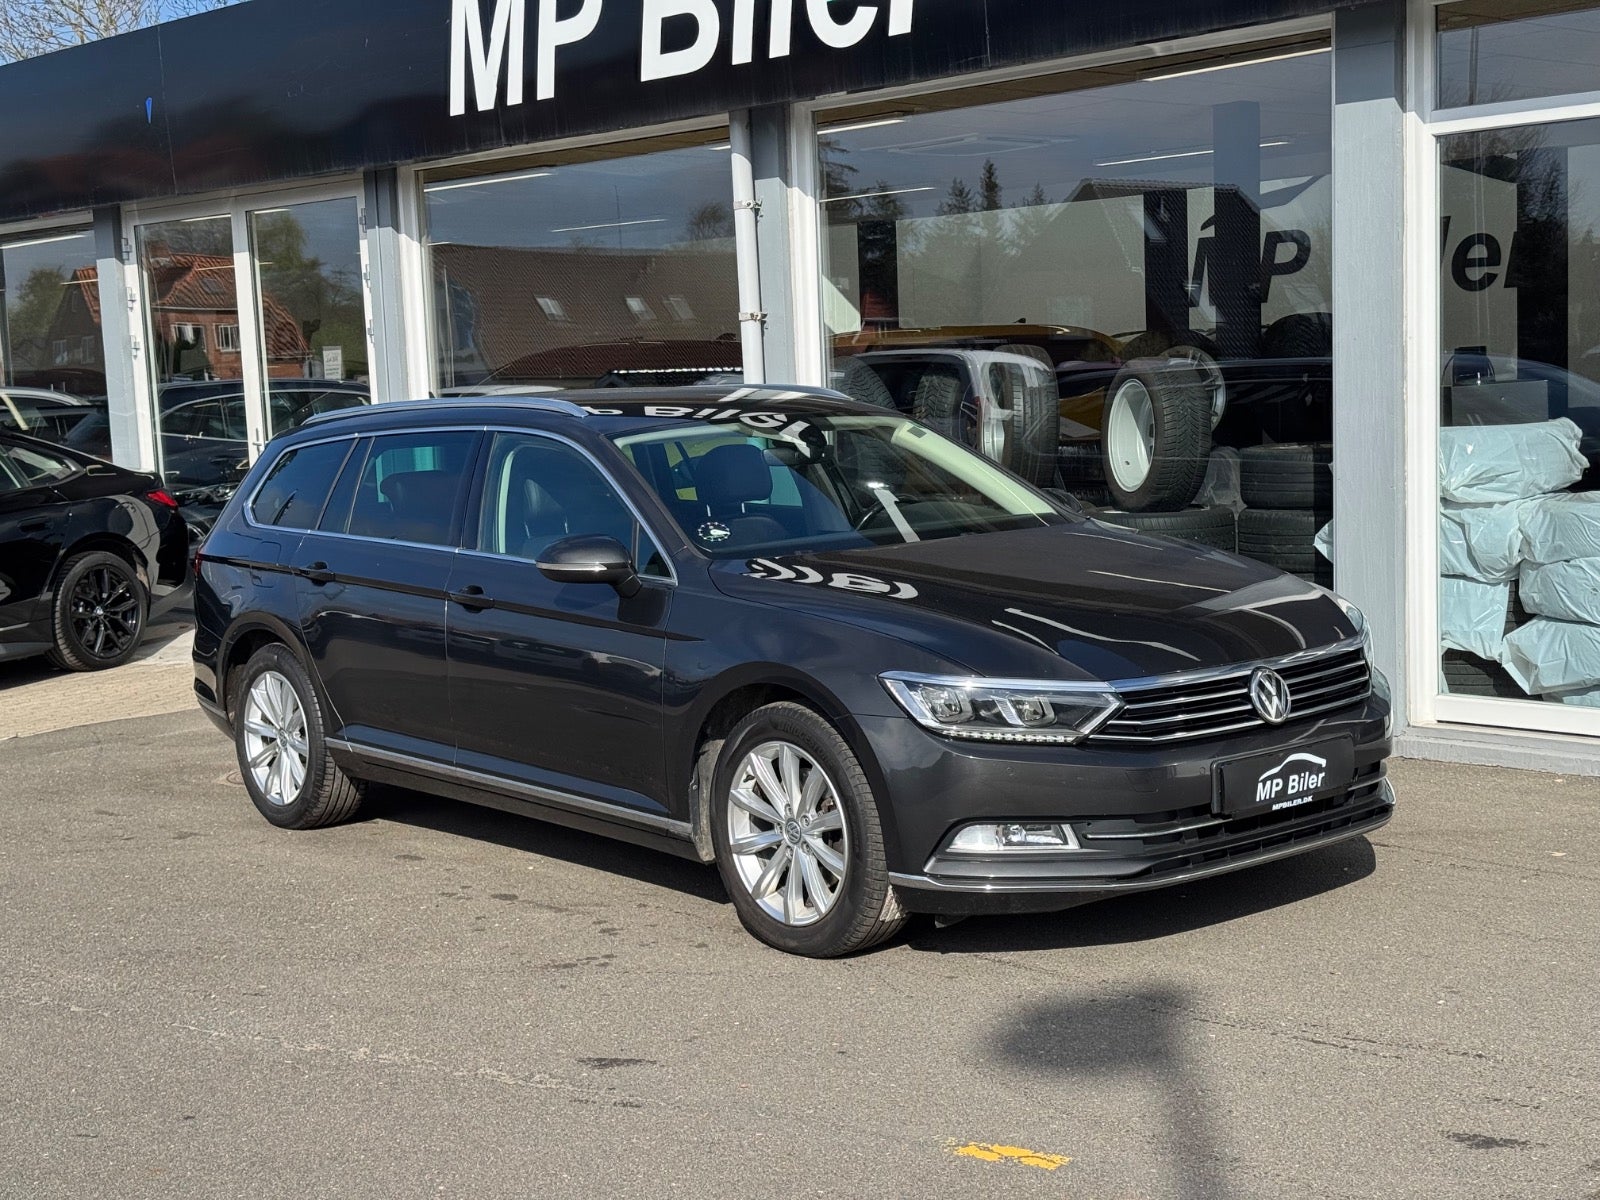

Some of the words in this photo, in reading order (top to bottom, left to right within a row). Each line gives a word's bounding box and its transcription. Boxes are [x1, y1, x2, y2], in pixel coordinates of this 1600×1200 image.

[450, 0, 602, 116] MP
[1256, 778, 1283, 802] MP
[1287, 771, 1326, 795] Biler
[1271, 795, 1314, 811] MPBILER.DK
